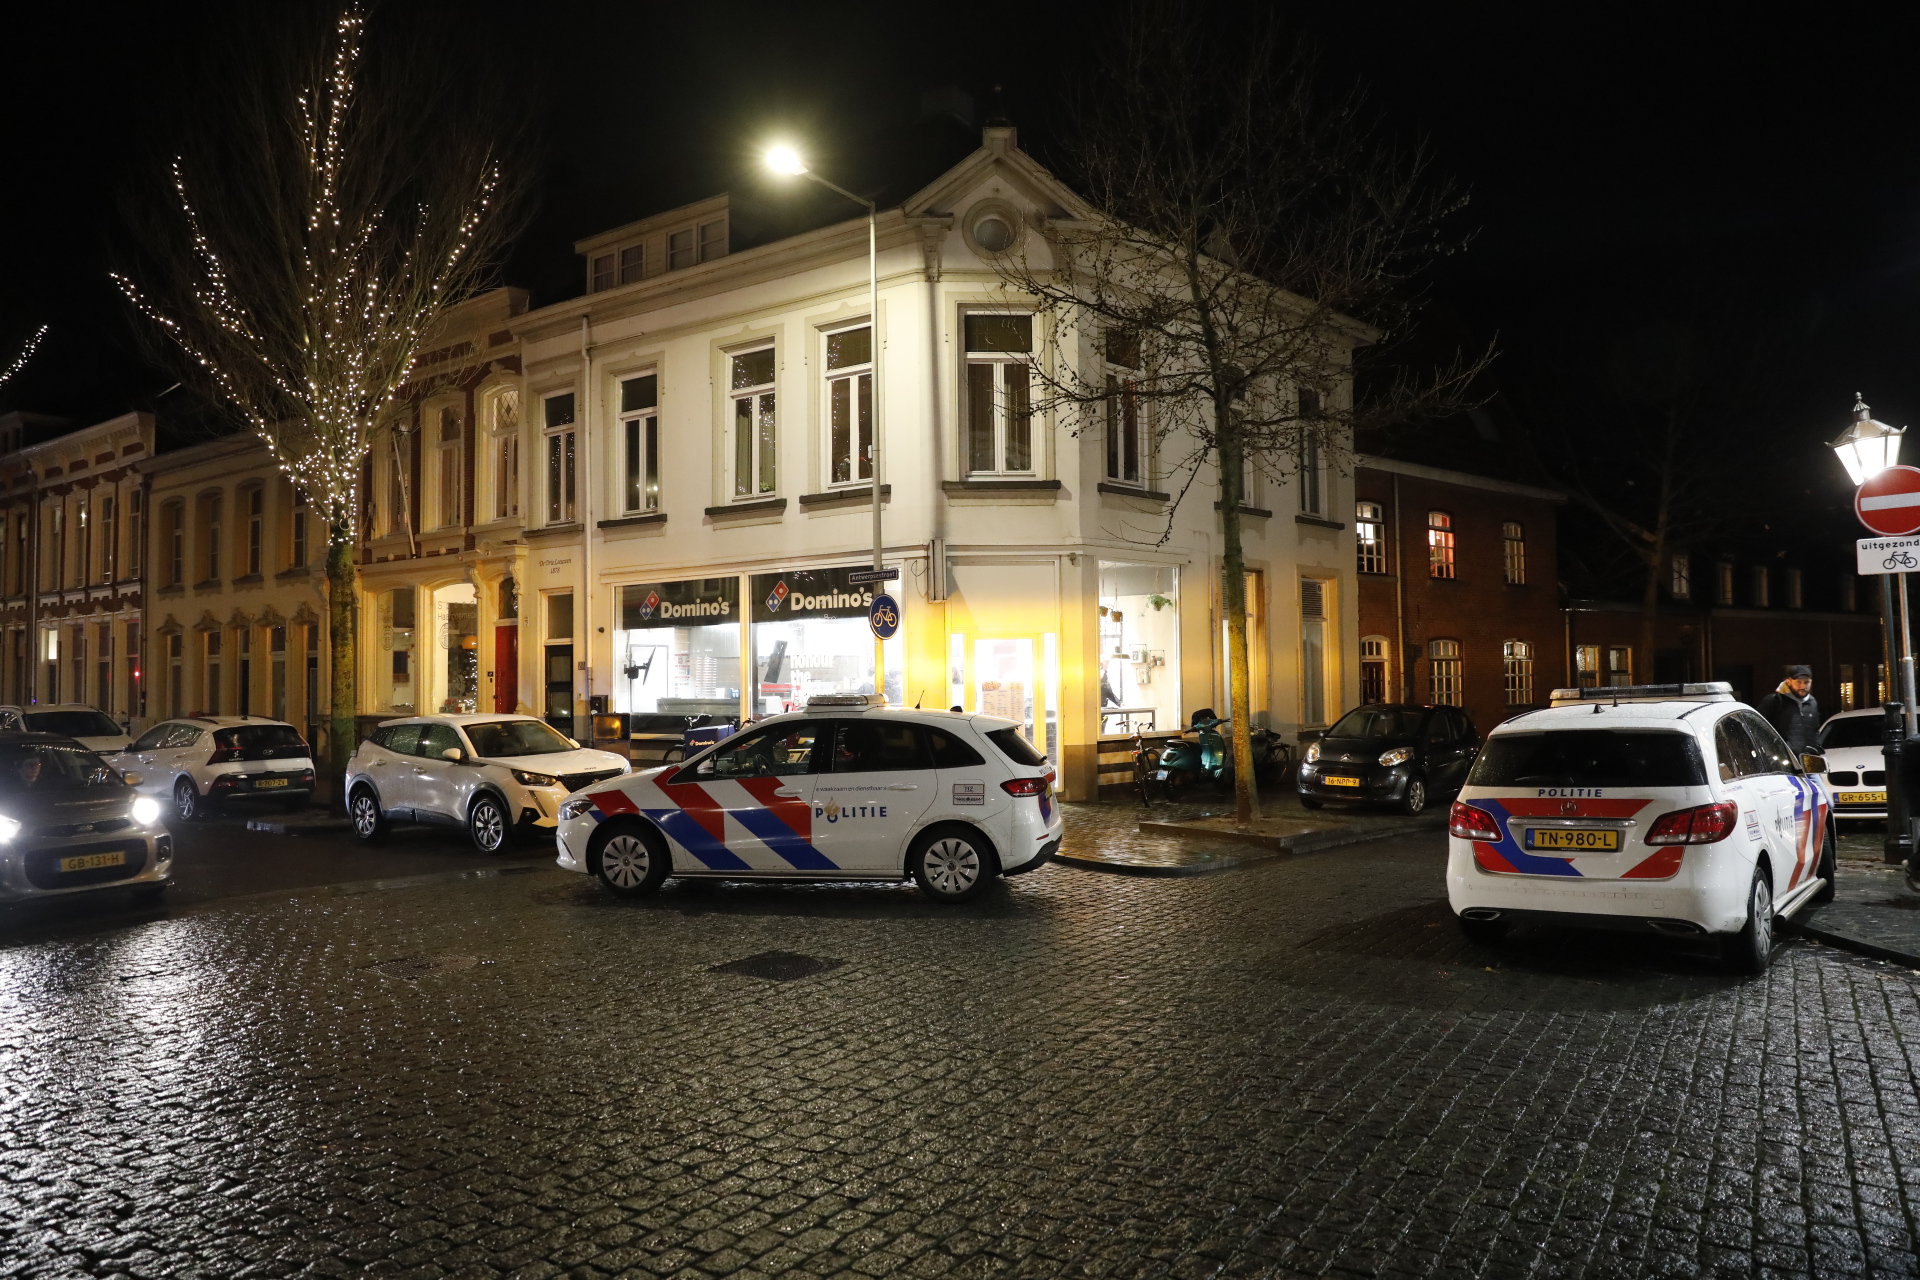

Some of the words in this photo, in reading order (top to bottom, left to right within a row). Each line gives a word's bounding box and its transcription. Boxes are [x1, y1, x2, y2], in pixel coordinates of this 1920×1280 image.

[851, 571, 896, 581] Antwerpsestraat
[661, 597, 730, 618] Domino's
[790, 587, 872, 611] Domino's
[1538, 788, 1602, 798] POLITIE
[815, 806, 888, 824] POLITIE
[1539, 832, 1611, 846] TN-980-L
[68, 853, 120, 870] GB-131-H
